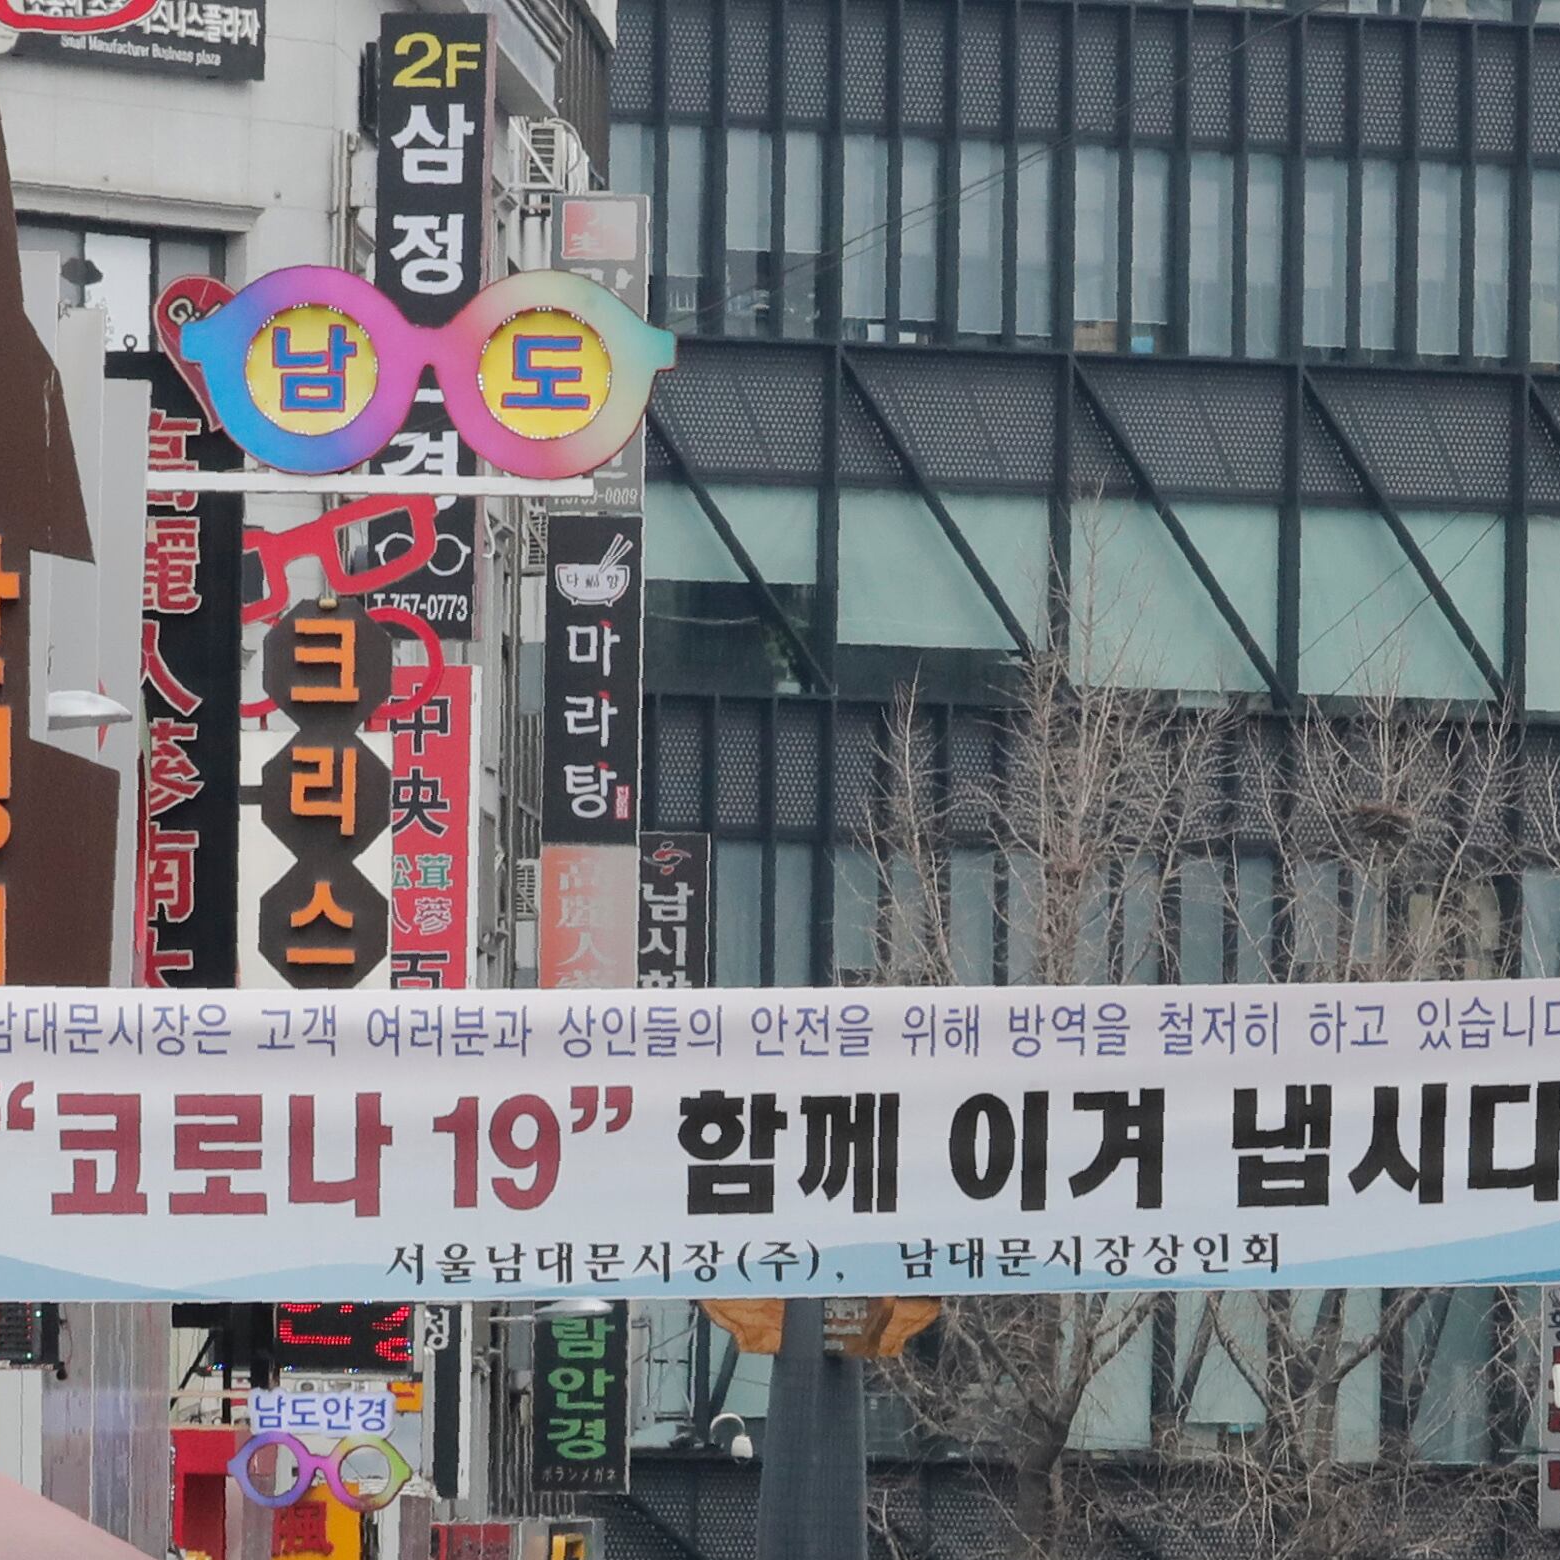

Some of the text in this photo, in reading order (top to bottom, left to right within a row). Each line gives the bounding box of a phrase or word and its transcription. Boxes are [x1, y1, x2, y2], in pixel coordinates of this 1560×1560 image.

[393, 32, 481, 88] 2F
[561, 619, 619, 819] 마라탕
[256, 1004, 338, 1057] 고객
[366, 1004, 532, 1057] 여러분과
[558, 1004, 724, 1058] 상인들의
[751, 1003, 873, 1057] 안전을
[902, 1003, 980, 1057] 위해
[1009, 1002, 1131, 1058] 방역을
[1158, 1000, 1279, 1057] 철저히
[1309, 999, 1390, 1054] 하고
[677, 1089, 900, 1216] 함께
[949, 1088, 1166, 1212] 이겨
[898, 1232, 1280, 1283] 남대문시장상인회
[254, 1392, 388, 1433] 남도안경
